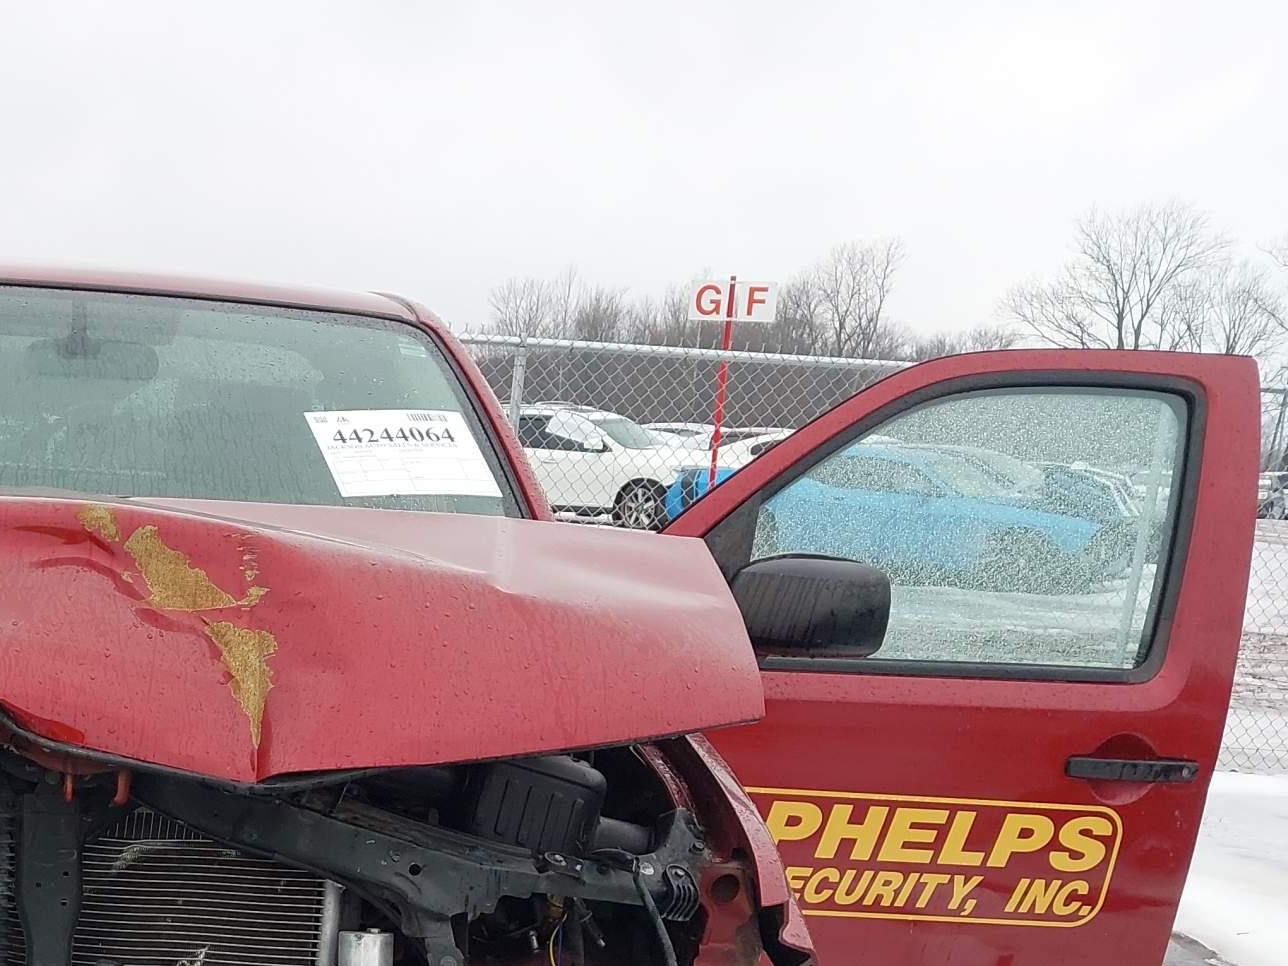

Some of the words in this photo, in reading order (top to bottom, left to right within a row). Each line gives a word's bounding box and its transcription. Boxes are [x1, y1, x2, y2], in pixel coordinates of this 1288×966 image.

[333, 427, 456, 443] 44244064
[765, 801, 1113, 872] PHELPS
[785, 866, 986, 916] ECURITY,
[1005, 877, 1093, 916] INC.
